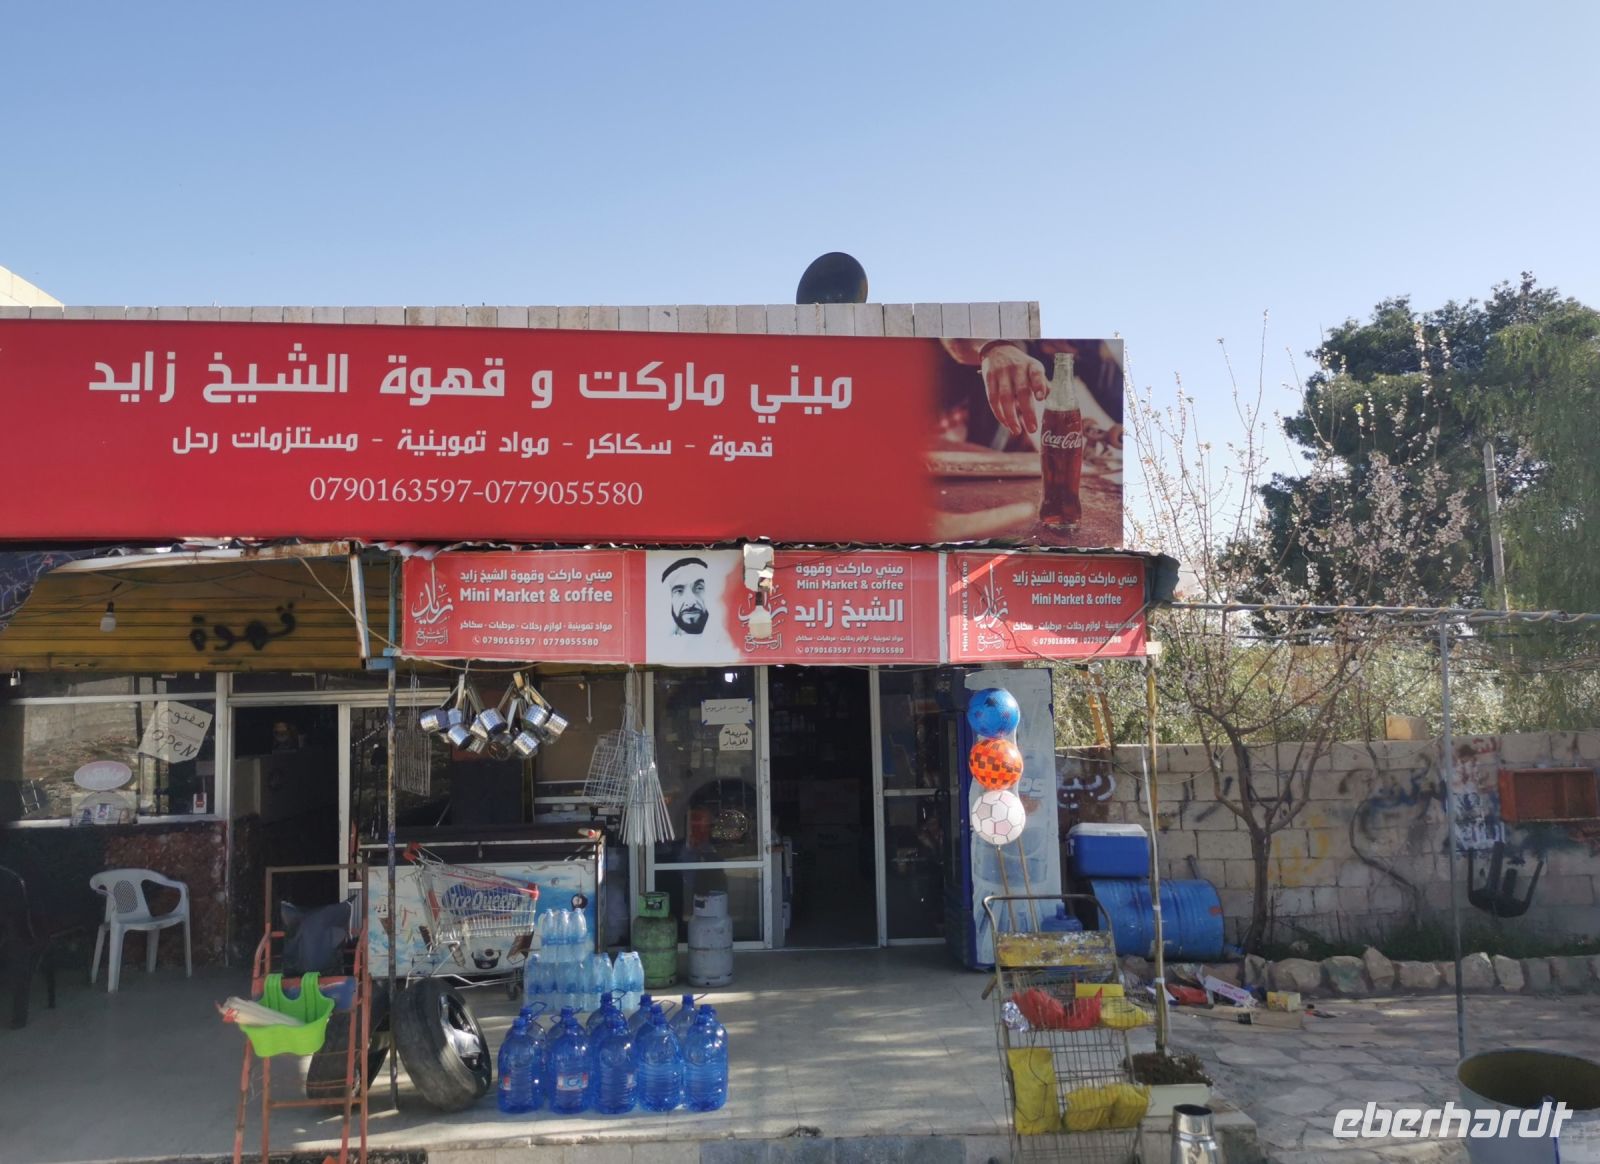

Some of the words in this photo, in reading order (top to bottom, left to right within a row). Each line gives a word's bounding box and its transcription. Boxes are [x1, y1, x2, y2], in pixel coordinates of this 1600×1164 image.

[89, 351, 175, 402] زايد
[203, 343, 348, 403] الشيخ
[379, 355, 505, 406] قهوة
[531, 370, 553, 409] و
[579, 361, 725, 411] ماركت
[750, 365, 852, 424] ميني
[173, 427, 218, 454] رحل
[232, 427, 358, 454] مستلزمات
[397, 428, 486, 456] تموينية
[499, 431, 549, 458] مواد
[586, 433, 671, 459] سكاكر
[709, 434, 773, 461] قهوة
[310, 476, 643, 505] 0790163597-0779055580
[460, 569, 477, 582] زايد
[480, 568, 507, 584] الشيخ
[511, 569, 544, 584] وقهوة
[548, 568, 582, 583] ماركت
[586, 568, 613, 584] ميني
[796, 562, 832, 577] وقهوة
[835, 563, 872, 576] ماركت
[875, 563, 904, 578] ميني
[796, 579, 819, 590] Mini
[821, 579, 858, 590] Market
[860, 580, 868, 590] &
[871, 579, 904, 590] coffee
[1012, 571, 1028, 586] زايد
[1031, 570, 1055, 586] الشيخ
[1057, 571, 1086, 587] وقهوة
[1088, 571, 1116, 587] ماركت
[1118, 572, 1138, 588] ميني
[460, 588, 490, 602] Mini
[494, 588, 545, 602] Market
[550, 588, 560, 603] &
[565, 586, 613, 602] coffee
[1032, 593, 1051, 605] Mini
[1053, 593, 1084, 605] Market
[1086, 594, 1095, 605] &
[1095, 593, 1121, 605] coffee
[794, 598, 834, 628] زايد
[841, 596, 904, 628] الشيخ
[595, 621, 612, 632] مواد
[482, 636, 535, 646] 0790163597
[543, 637, 599, 647] 0779055580
